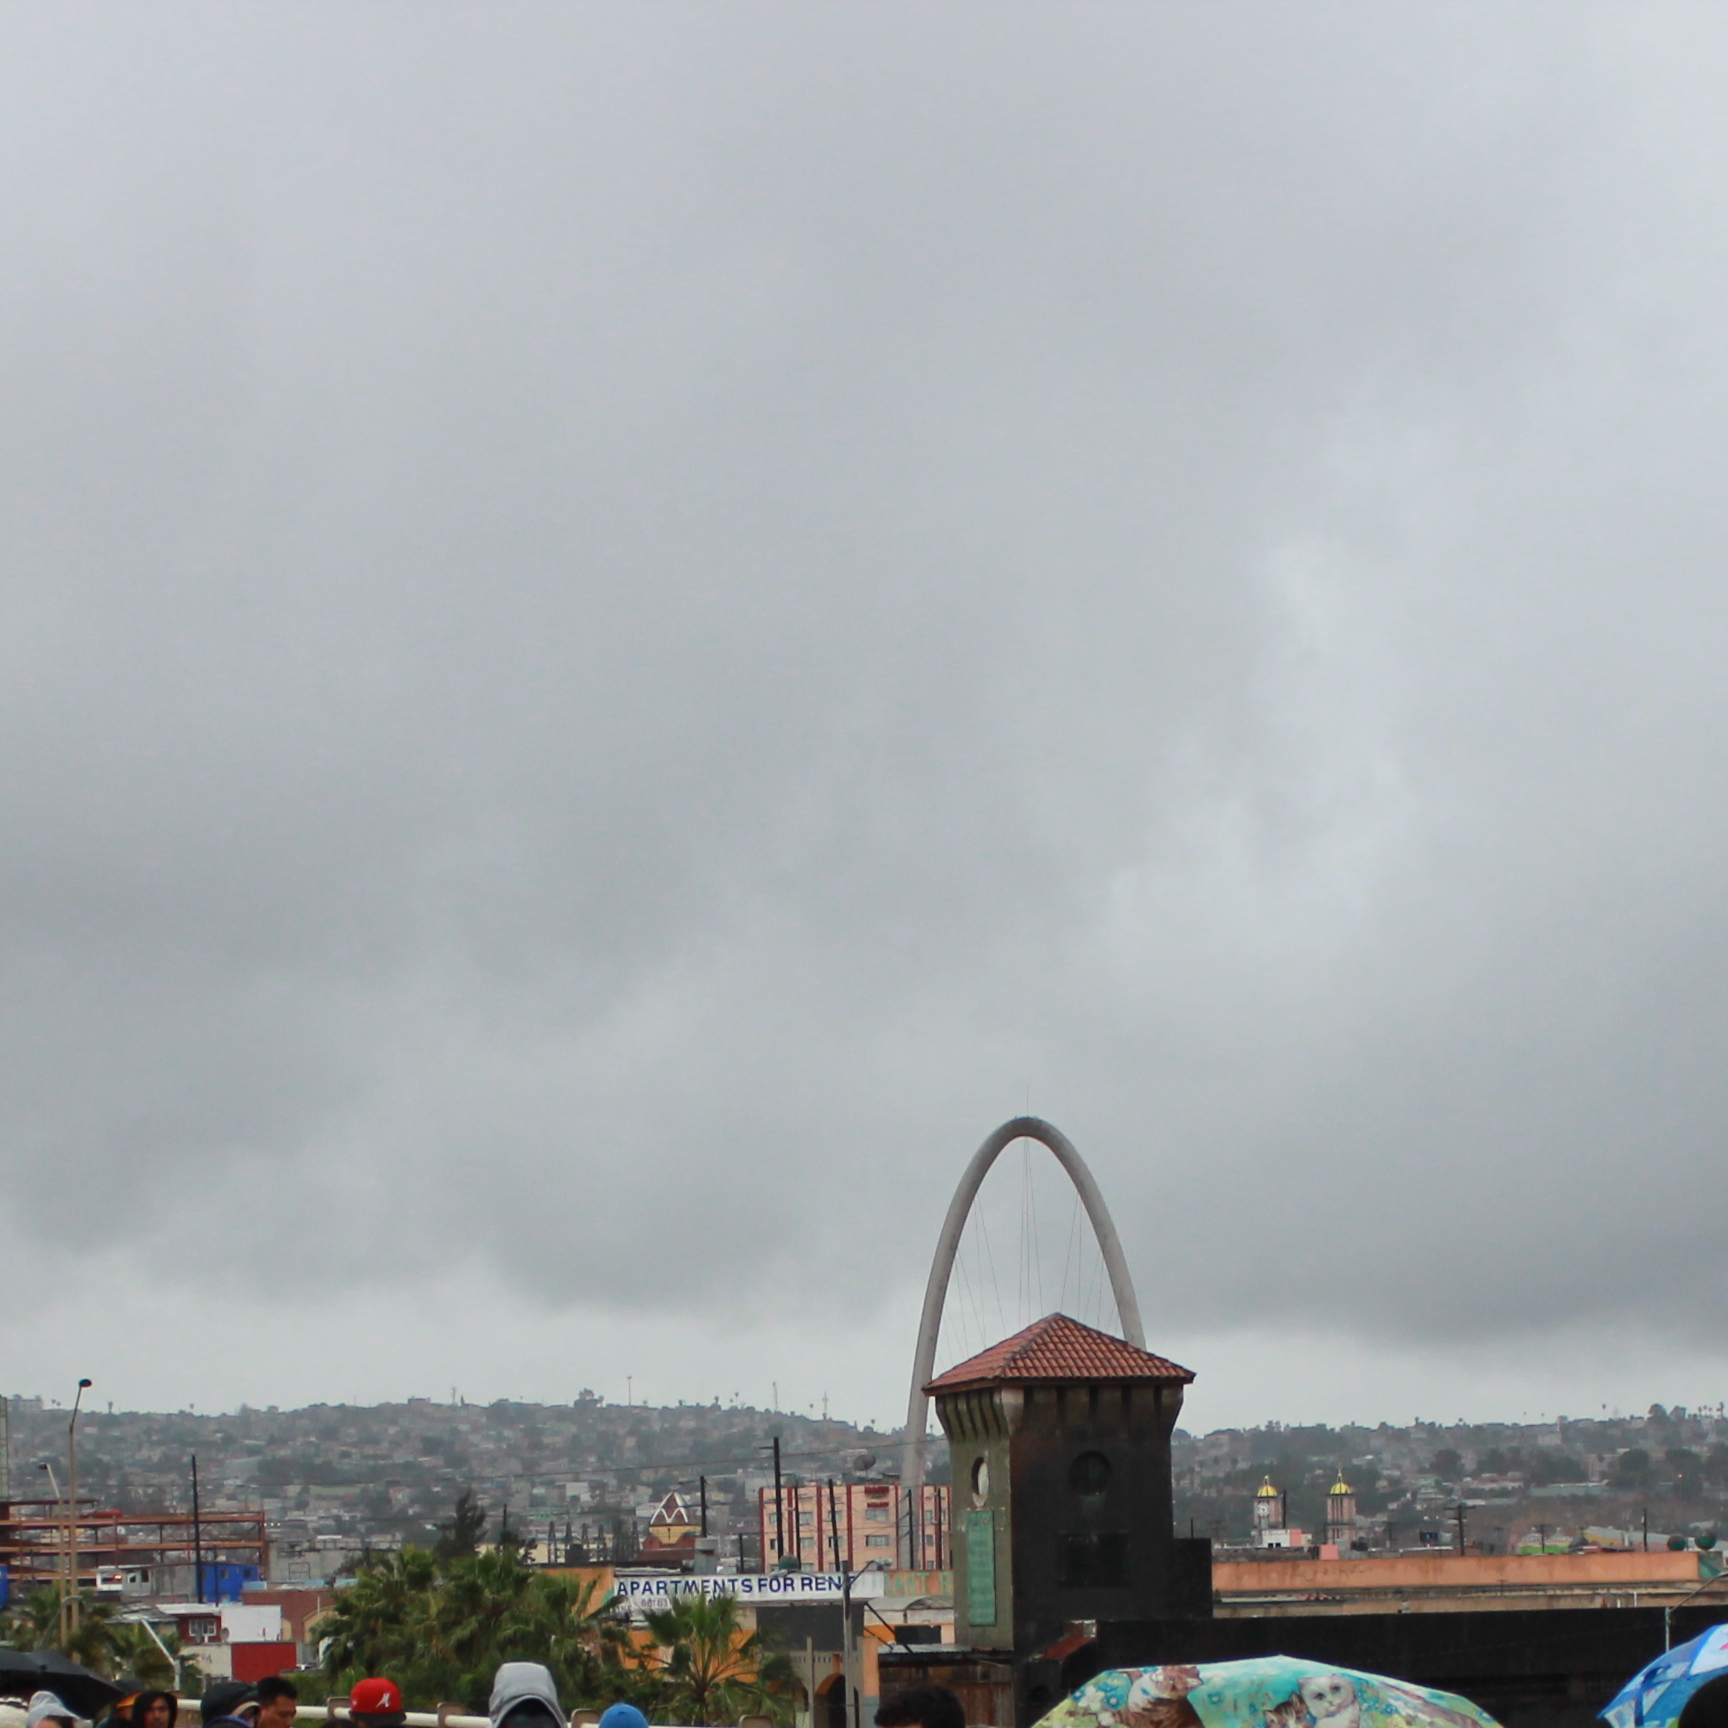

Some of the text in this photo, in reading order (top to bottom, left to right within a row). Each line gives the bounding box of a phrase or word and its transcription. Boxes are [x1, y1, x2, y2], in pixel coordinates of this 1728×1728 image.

[617, 1575, 857, 1596] APARTMENTS FOR REN
